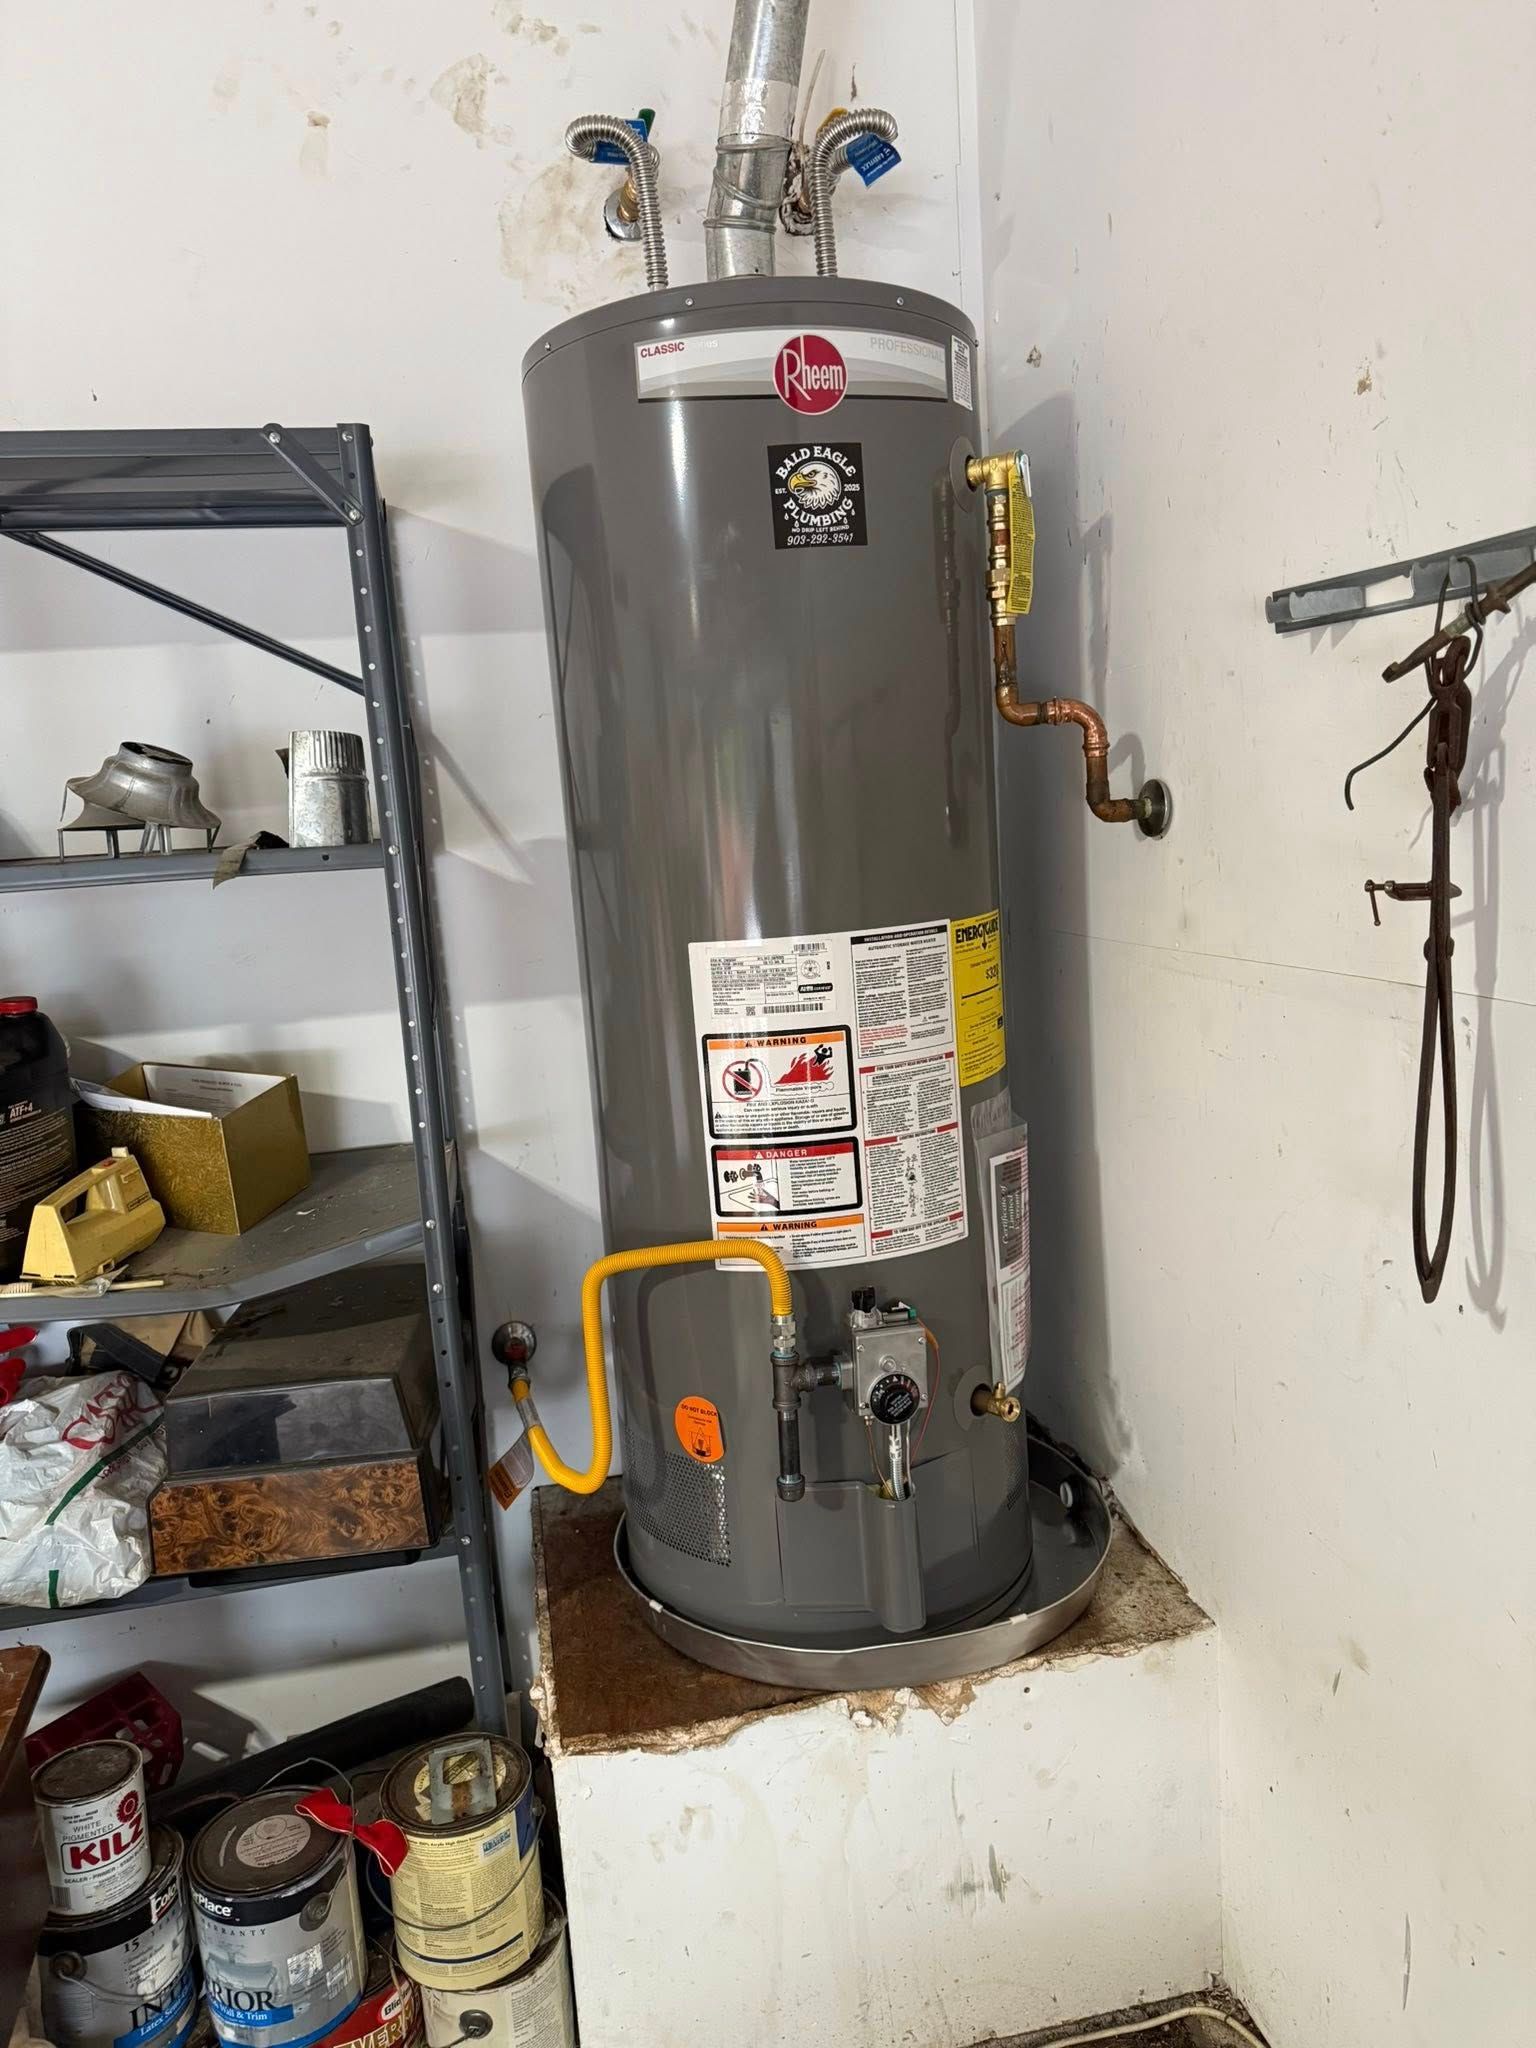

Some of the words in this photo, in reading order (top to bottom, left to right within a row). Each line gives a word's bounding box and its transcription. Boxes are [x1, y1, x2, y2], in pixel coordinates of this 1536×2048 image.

[640, 341, 685, 358] CLASSIC
[870, 337, 944, 363] PROFESSIONAL
[781, 334, 845, 400] Rheem
[776, 447, 810, 480] BALD
[813, 445, 857, 477] EAGLE
[783, 496, 853, 527] PLUMBING
[757, 1037, 807, 1047] WARNING
[10, 1102, 33, 1119] ATF+4
[766, 1149, 808, 1159] DANGER
[773, 1220, 817, 1231] WARNING
[700, 1409, 718, 1417] BLOCK
[62, 1823, 114, 1842] PIGMENTED
[73, 1820, 101, 1833] WHITE
[69, 1812, 144, 1869] KILZ
[64, 1876, 88, 1884] SEALER
[124, 1938, 140, 1953] 15
[219, 2005, 236, 2019] Wall
[236, 2010, 245, 2020] &
[246, 2011, 268, 2021] Trim
[140, 2016, 163, 2036] Latex
